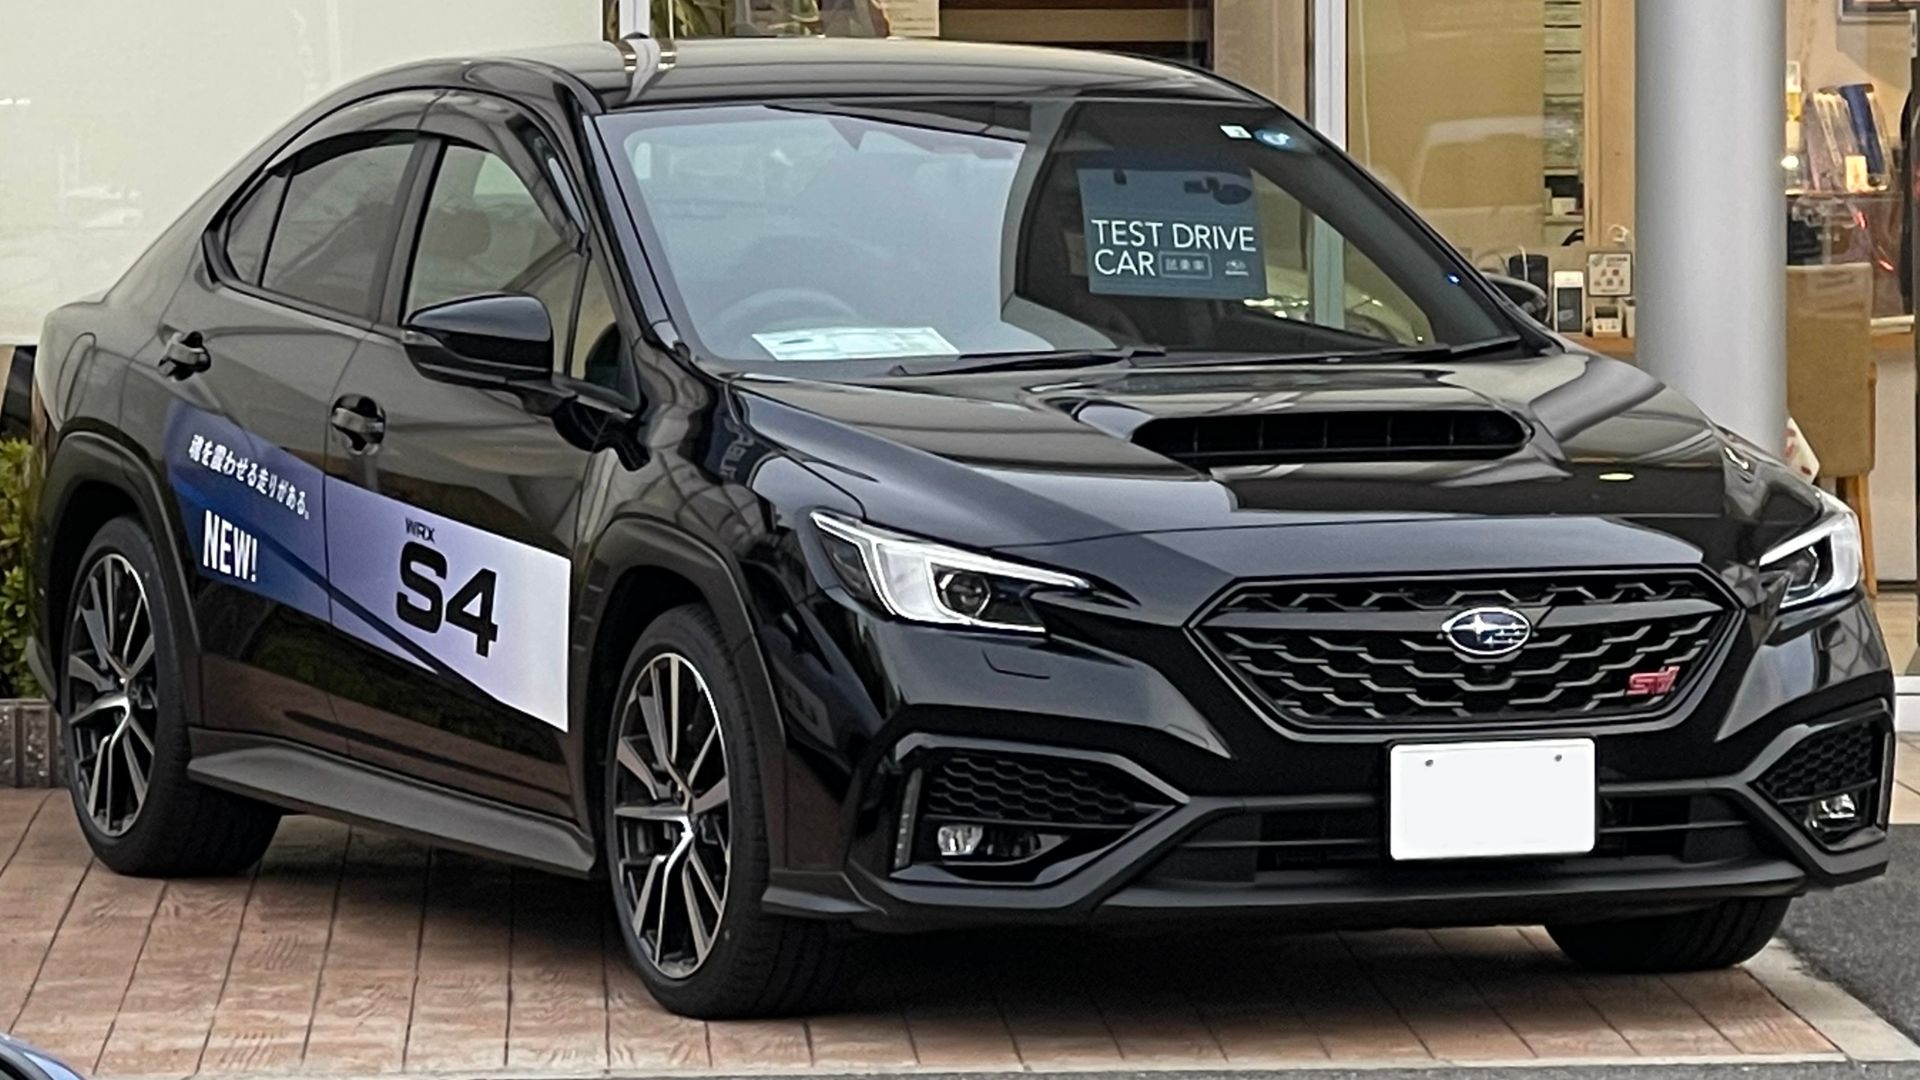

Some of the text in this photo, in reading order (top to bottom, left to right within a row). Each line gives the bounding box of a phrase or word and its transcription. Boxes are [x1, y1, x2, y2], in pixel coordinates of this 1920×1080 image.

[1091, 219, 1257, 253] TEST DRIVE
[1094, 249, 1156, 277] CAR
[202, 509, 258, 583] NEW!
[404, 517, 435, 543] WRX
[396, 541, 499, 658] S4
